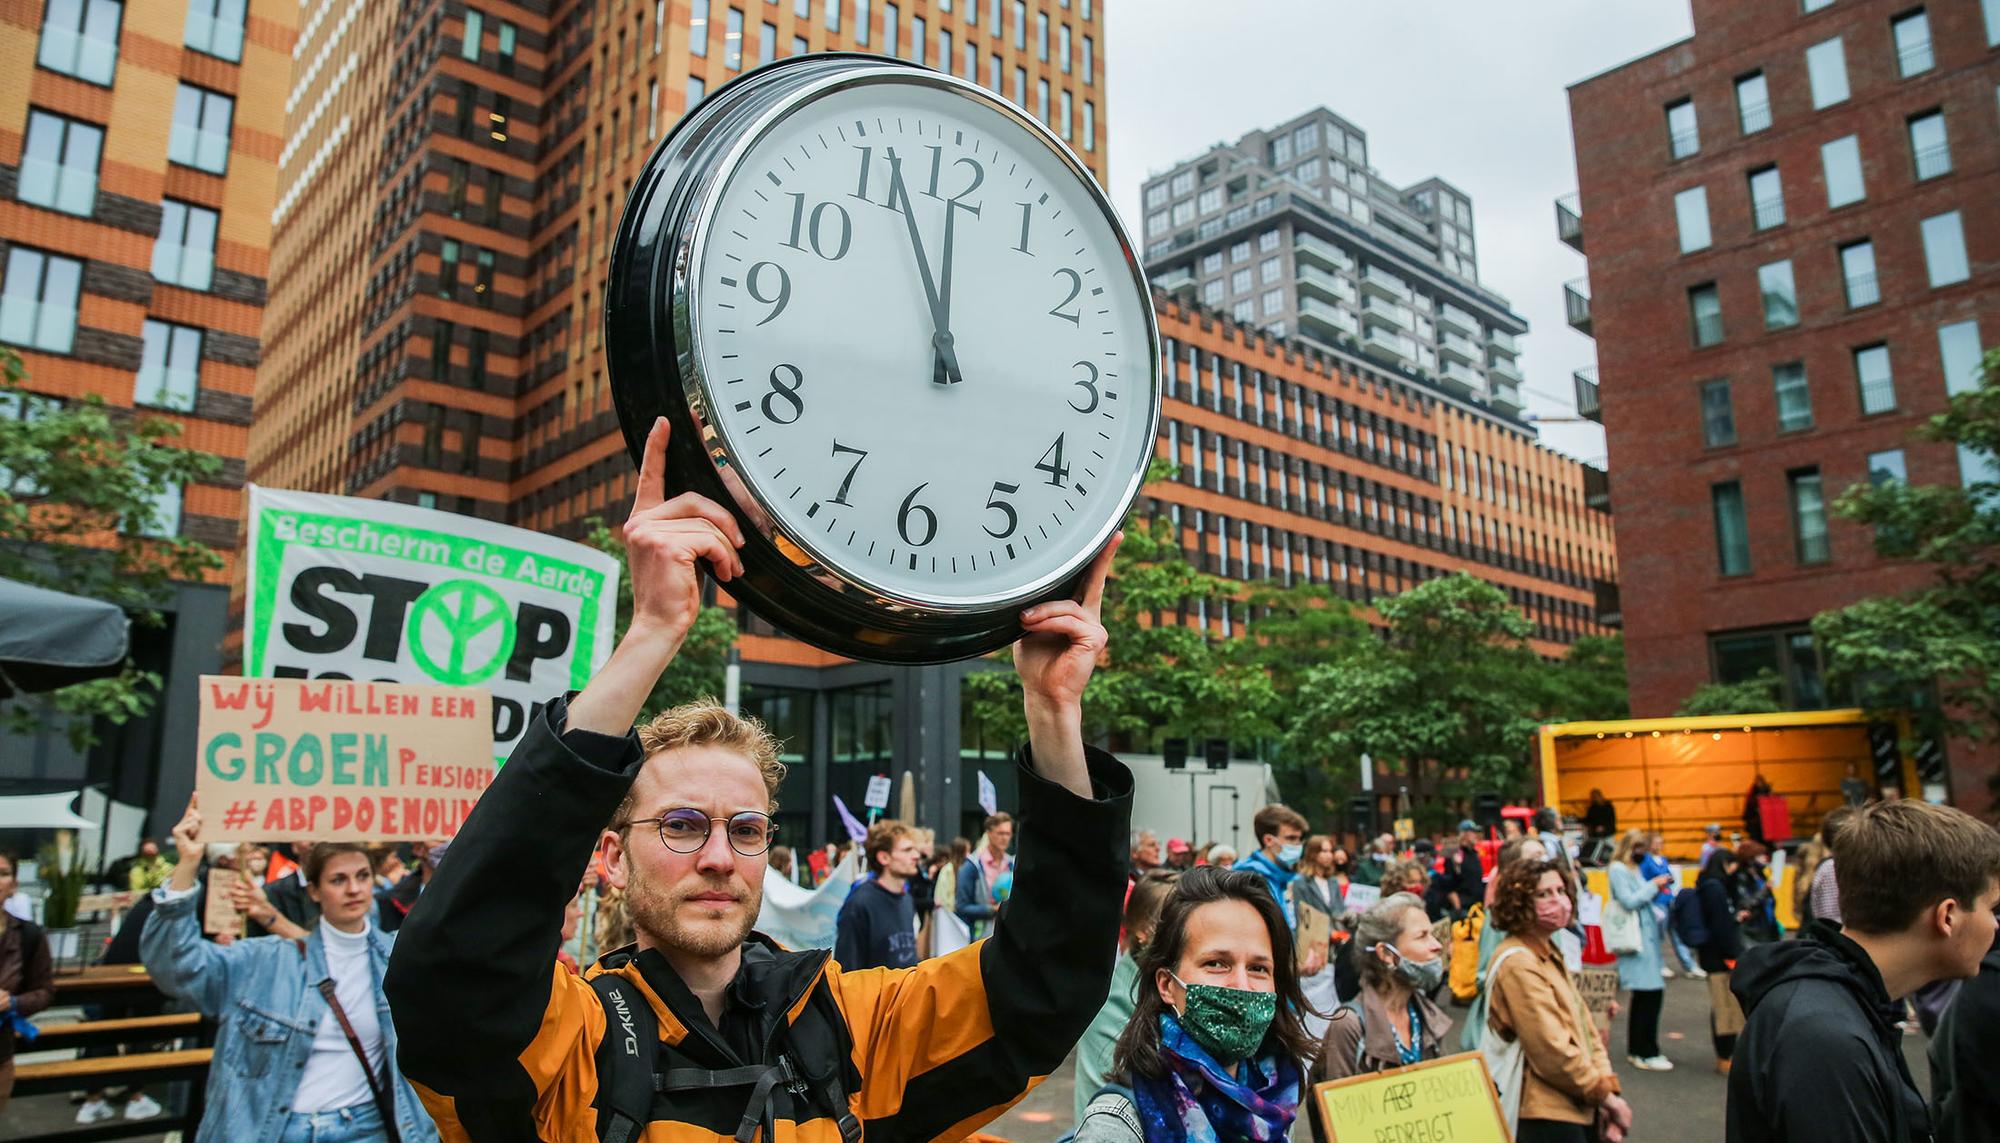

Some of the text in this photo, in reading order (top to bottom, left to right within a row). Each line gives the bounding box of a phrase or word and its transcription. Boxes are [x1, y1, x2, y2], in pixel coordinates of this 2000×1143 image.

[847, 145, 905, 215] 11
[919, 145, 985, 221] 12
[778, 192, 853, 261] 10
[1010, 201, 1036, 257] 1
[746, 261, 792, 327] 9
[1049, 267, 1082, 328] 2
[760, 363, 805, 425] 8
[1066, 360, 1100, 414] 3
[826, 438, 868, 508] 7
[1033, 431, 1071, 489] 4
[897, 482, 938, 546] 6
[982, 481, 1020, 539] 5
[274, 515, 595, 599] Bescherm de Aarde
[431, 695, 476, 720] EEN
[205, 732, 390, 787] GROEN
[609, 988, 639, 1058] DAKINE
